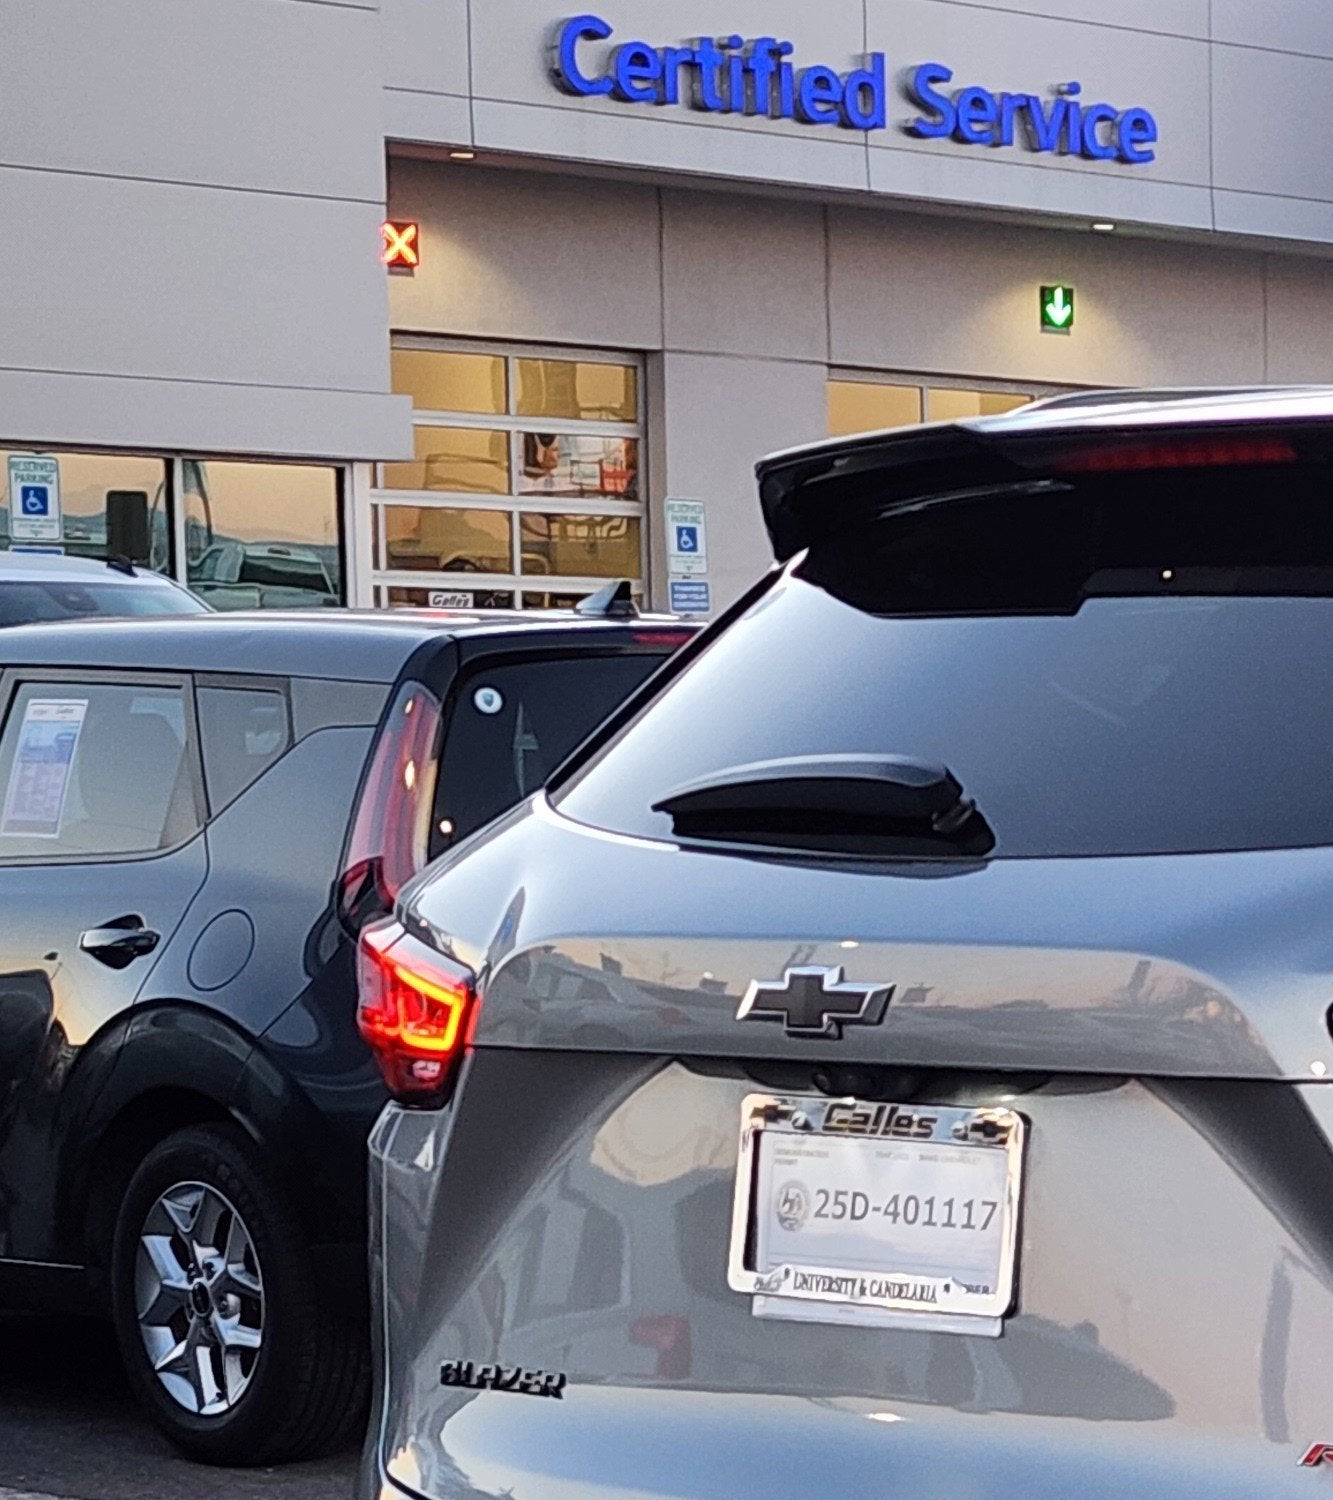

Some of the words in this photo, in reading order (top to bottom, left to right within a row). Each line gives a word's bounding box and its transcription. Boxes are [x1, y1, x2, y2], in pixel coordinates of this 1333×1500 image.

[553, 14, 887, 130] Certified
[906, 62, 1157, 163] Service
[824, 1102, 937, 1138] Galles
[814, 1189, 998, 1231] 25D-401117
[794, 1272, 857, 1298] UNIVERSITY
[870, 1279, 938, 1303] CANDELARIA
[440, 1360, 566, 1399] BLAZER
